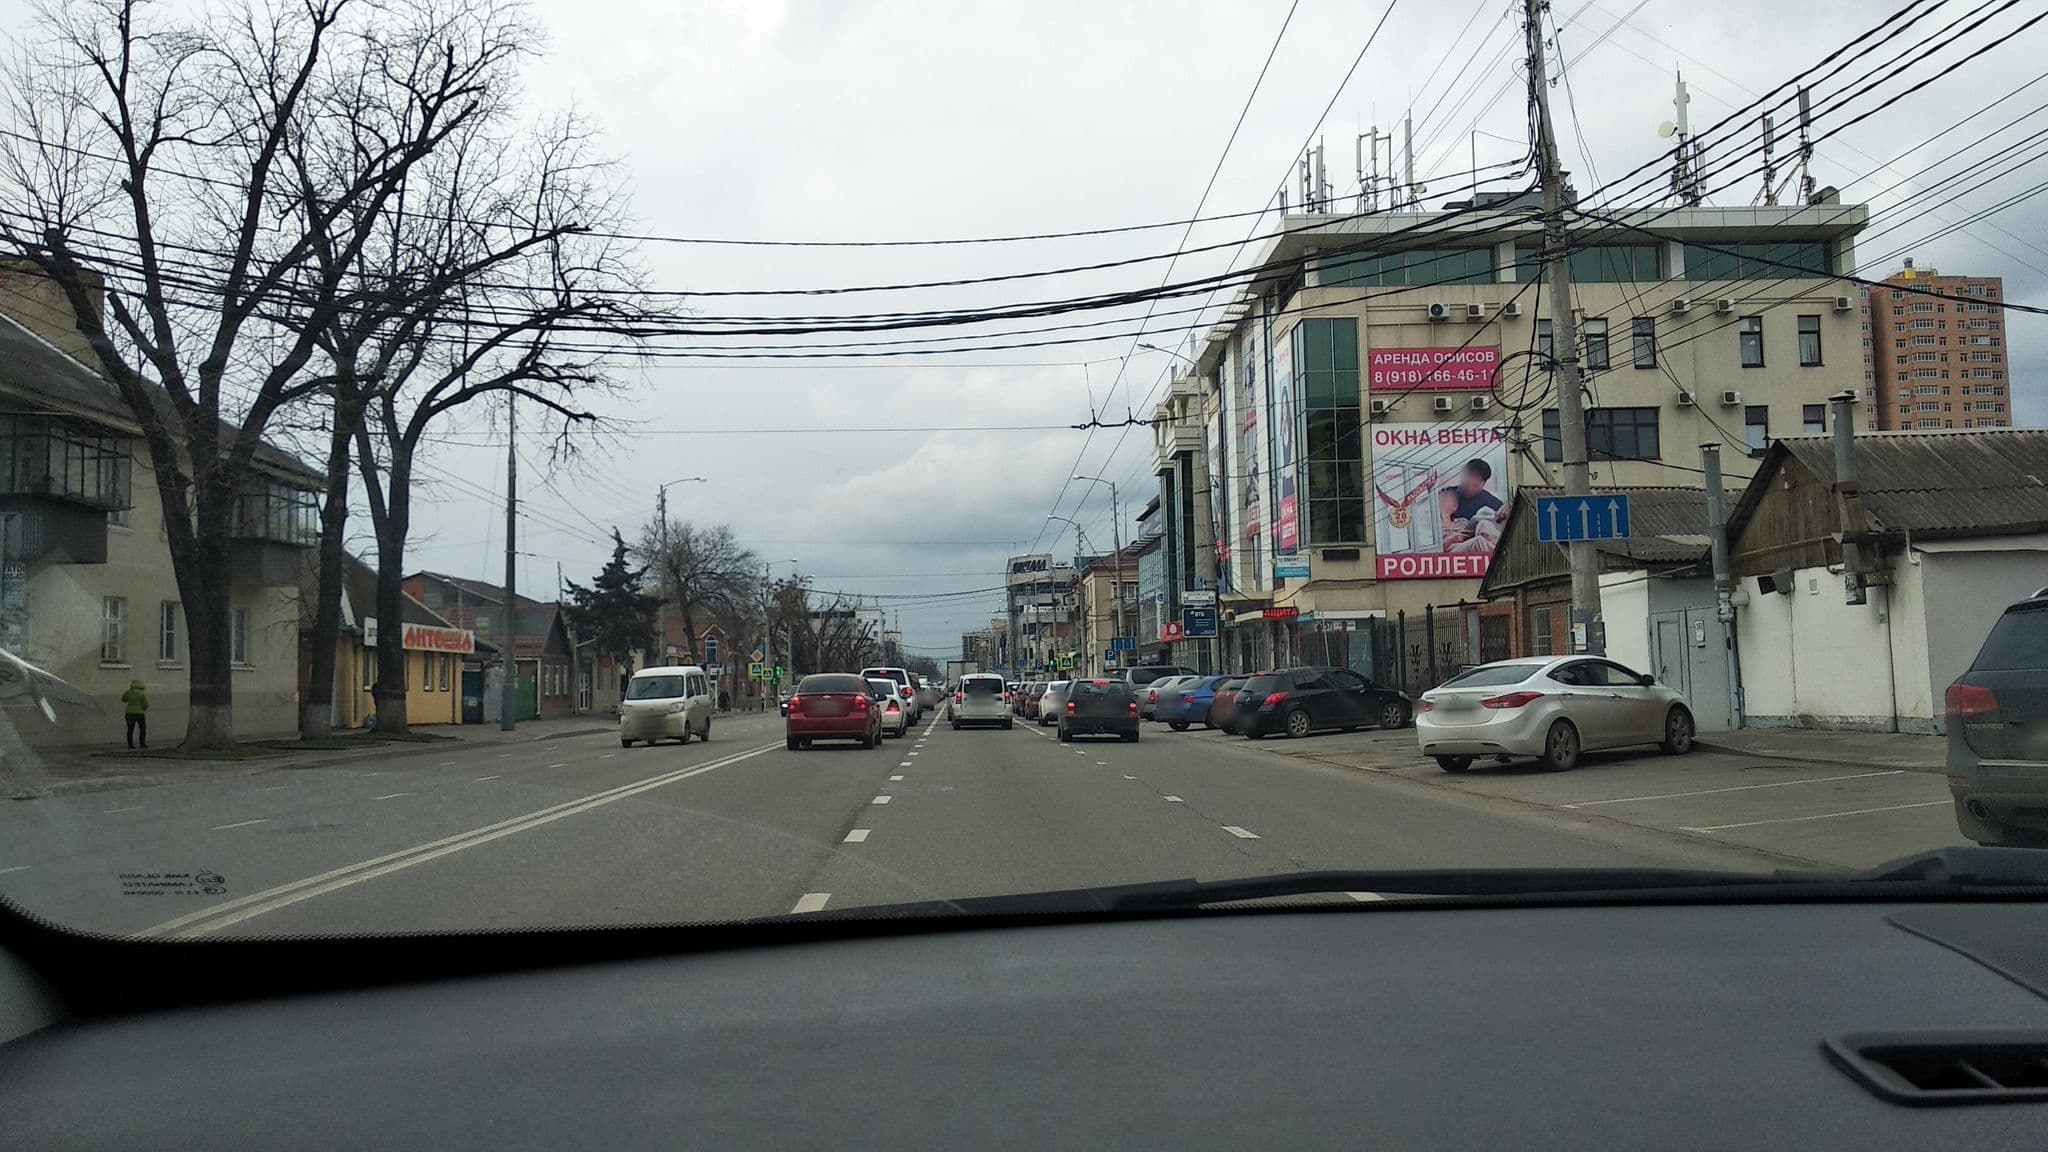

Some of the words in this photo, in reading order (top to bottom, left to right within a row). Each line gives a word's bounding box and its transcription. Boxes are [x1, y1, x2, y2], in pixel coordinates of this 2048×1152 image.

[1374, 353, 1430, 365] АРЕНДА
[1434, 351, 1495, 364] ОФИСОВ
[1375, 371, 1383, 383] 8
[1386, 370, 1422, 385] (918)
[1375, 430, 1432, 445] ОКНА
[1438, 428, 1502, 444] ВЕНТА
